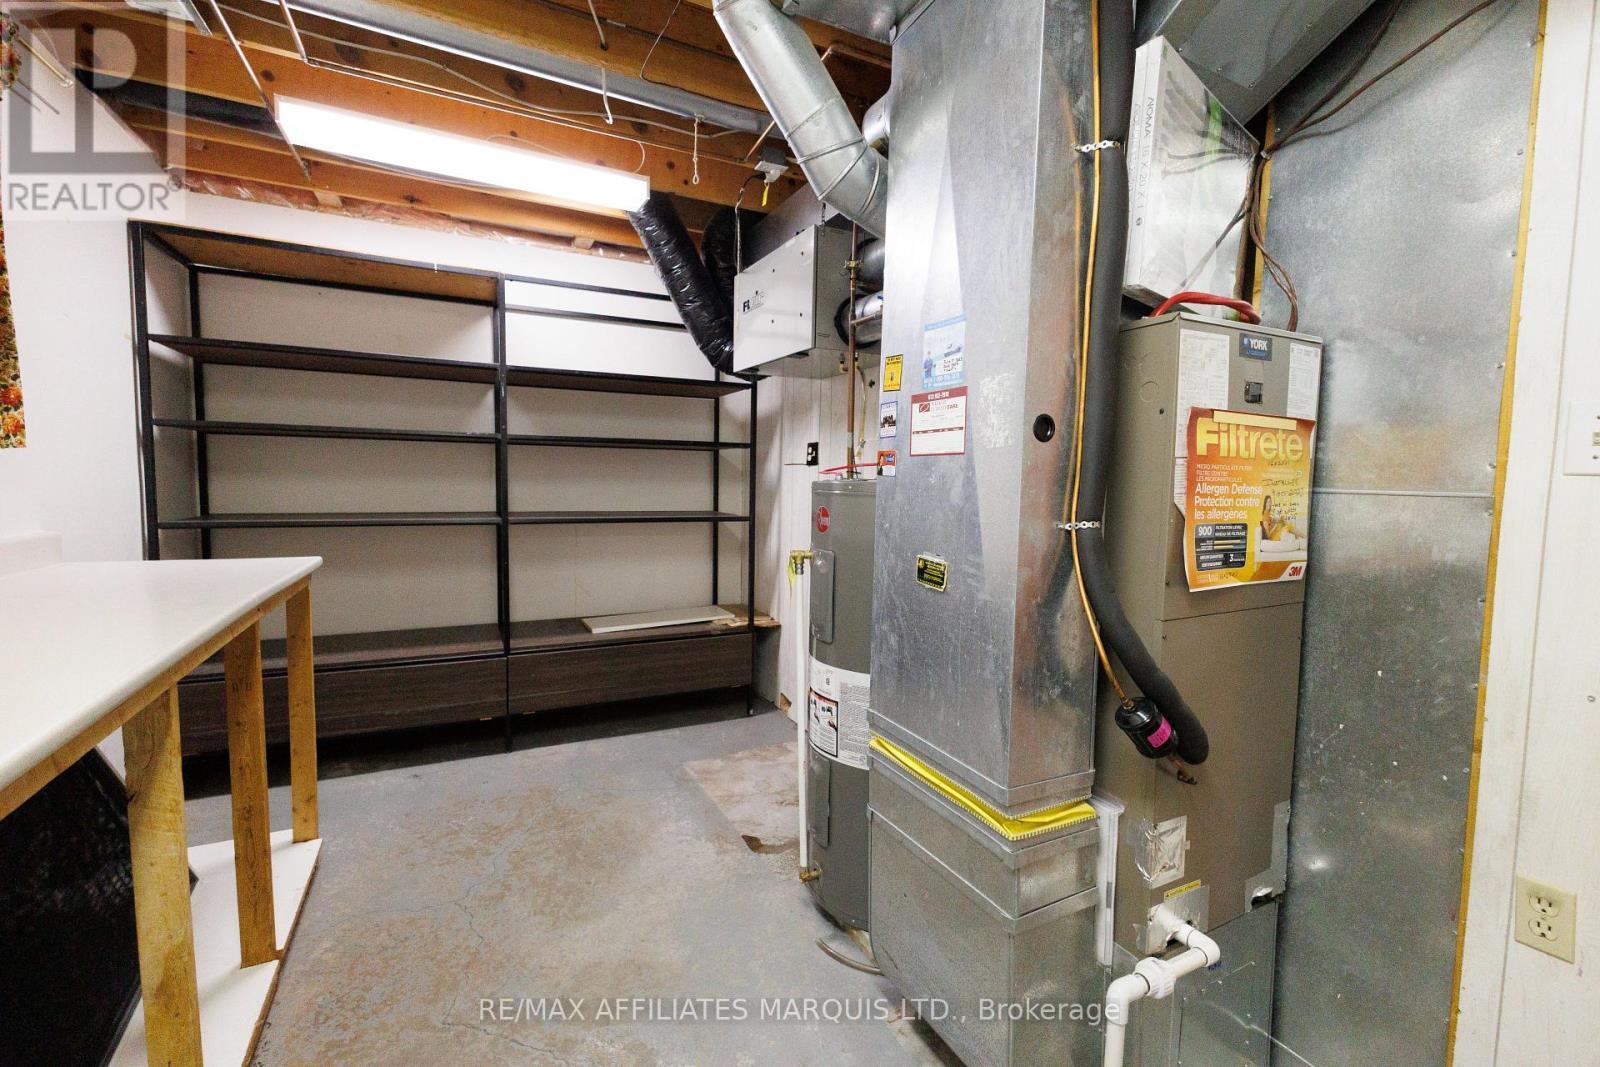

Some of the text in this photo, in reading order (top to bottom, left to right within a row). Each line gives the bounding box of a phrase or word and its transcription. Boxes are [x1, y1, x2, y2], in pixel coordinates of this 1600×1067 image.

[1249, 338, 1268, 351] YORK
[1196, 417, 1303, 462] Filtrete
[1195, 482, 1229, 496] Allergen
[1231, 483, 1264, 495] Defense
[1195, 496, 1260, 507] Protection contre
[1195, 508, 1205, 520] les
[1198, 526, 1213, 536] 900
[1289, 566, 1303, 577] 3M
